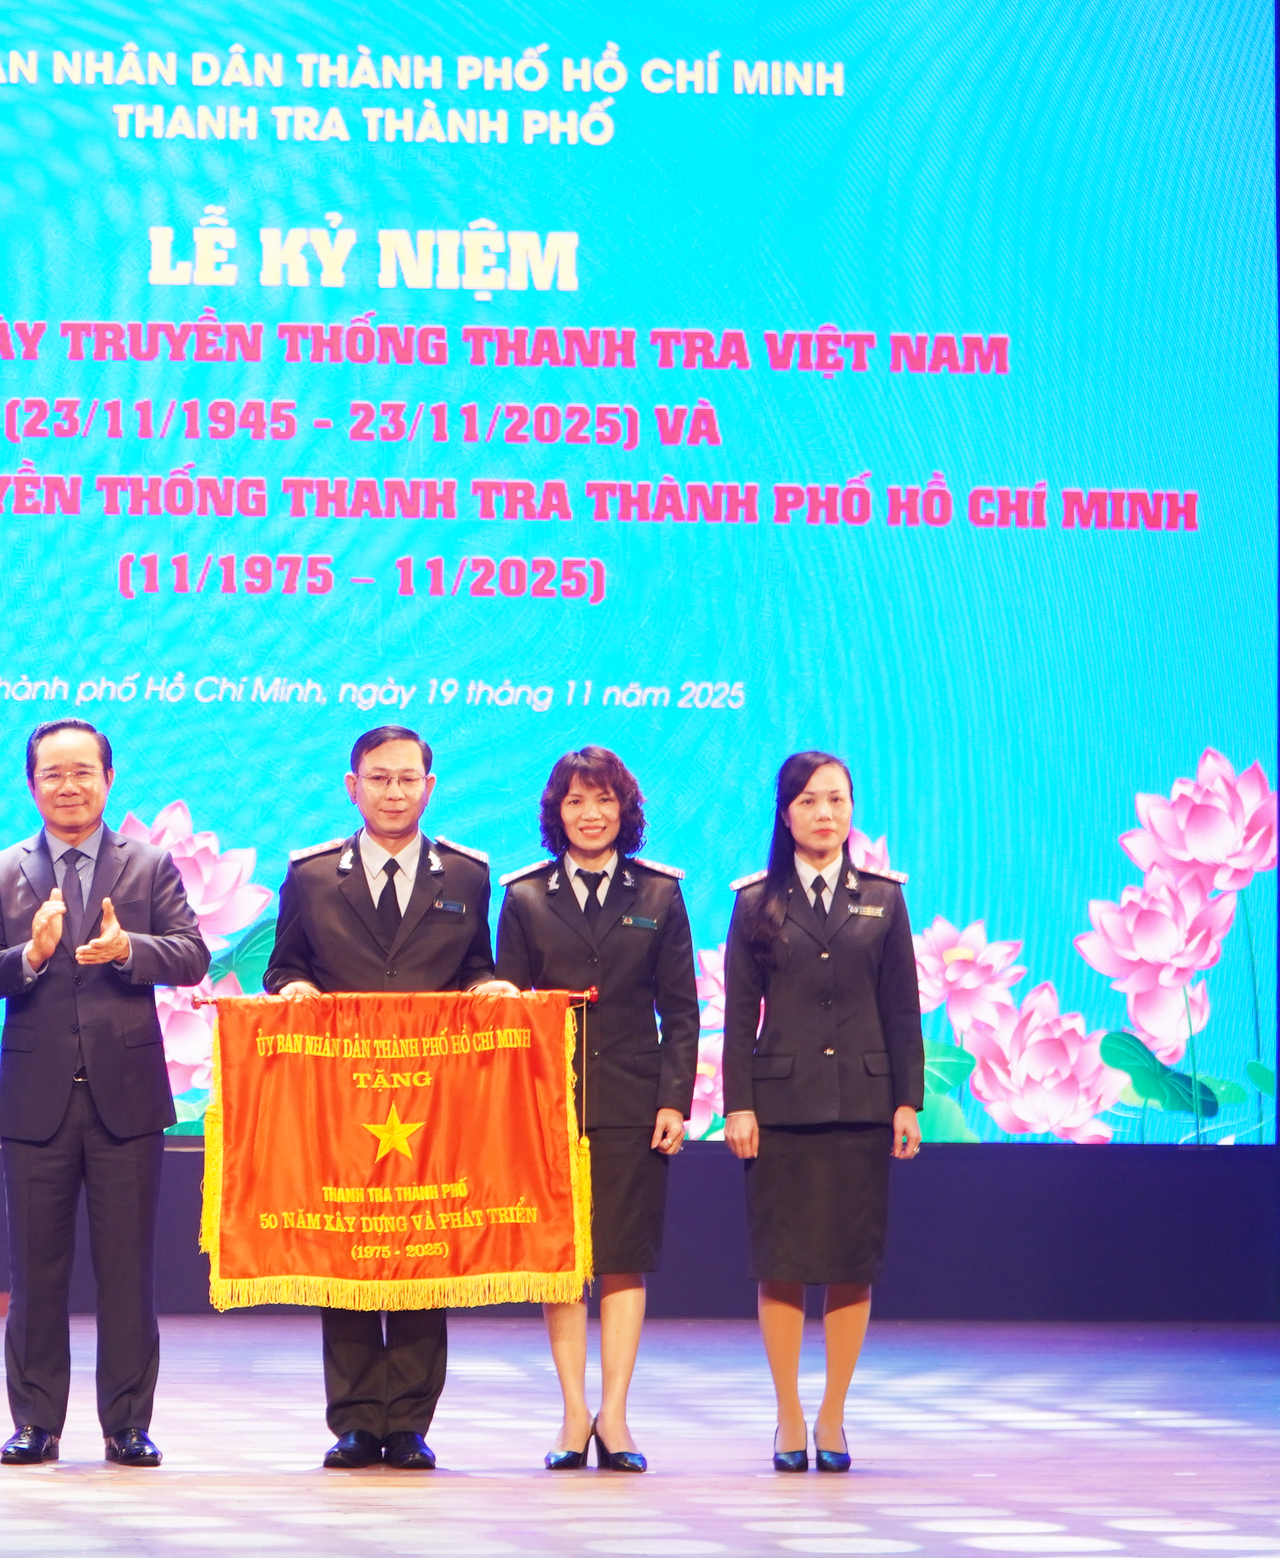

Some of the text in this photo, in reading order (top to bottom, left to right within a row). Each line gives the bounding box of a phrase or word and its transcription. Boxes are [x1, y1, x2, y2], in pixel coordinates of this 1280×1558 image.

[53, 42, 176, 86] NHÂN
[192, 44, 283, 87] DÂN
[297, 45, 442, 90] THÀNH
[458, 43, 548, 91] PHỐ
[563, 42, 627, 93] HỒ
[641, 50, 720, 94] CHÍ
[734, 61, 844, 96] MINH
[112, 97, 614, 145] THANH TRA THÀNH PHỐ
[149, 205, 578, 301] LỄ KỶ NIỆM
[60, 307, 263, 362] TRUYỀN
[277, 311, 448, 365] THỐNG
[462, 327, 636, 368] THANH
[650, 330, 750, 370] TRA
[764, 324, 876, 378] VIỆT
[890, 334, 1009, 375] NAM
[5, 400, 721, 450] (23/11/1945 - 23/11/2025) VÀ
[96, 463, 266, 517] THỐNG
[282, 479, 457, 519] THANH
[471, 481, 572, 520] TRA
[585, 476, 759, 523] THÀNH
[773, 471, 872, 525] PHỐ
[887, 472, 952, 527] HỒ
[968, 481, 1047, 529] CHÍ
[1062, 489, 1198, 532] MINH
[119, 554, 333, 599] (11/1975
[396, 557, 605, 604] 11/2025)
[75, 672, 140, 706] phố
[145, 672, 186, 702] Hồ
[194, 676, 247, 703] Chí
[252, 677, 327, 707] Minh,
[339, 677, 417, 711] ngày
[428, 678, 459, 704] 19
[467, 679, 553, 712] tháng
[566, 681, 593, 705] 11
[603, 683, 670, 708] năm
[678, 681, 744, 709] 2025
[256, 1024, 531, 1058] ỦY BAN NHÂN DÂN THÀNH PHỐ HỒ CHÍ MINH
[352, 1068, 432, 1092] TẶNG
[322, 1176, 468, 1203] THANH TRA THÀNH PHỐ
[260, 1196, 538, 1236] 50 NĂM XÂY DỰNG VÀ PHÁT TRIỂN
[350, 1244, 391, 1261] (1975
[405, 1241, 449, 1259] 2025)
